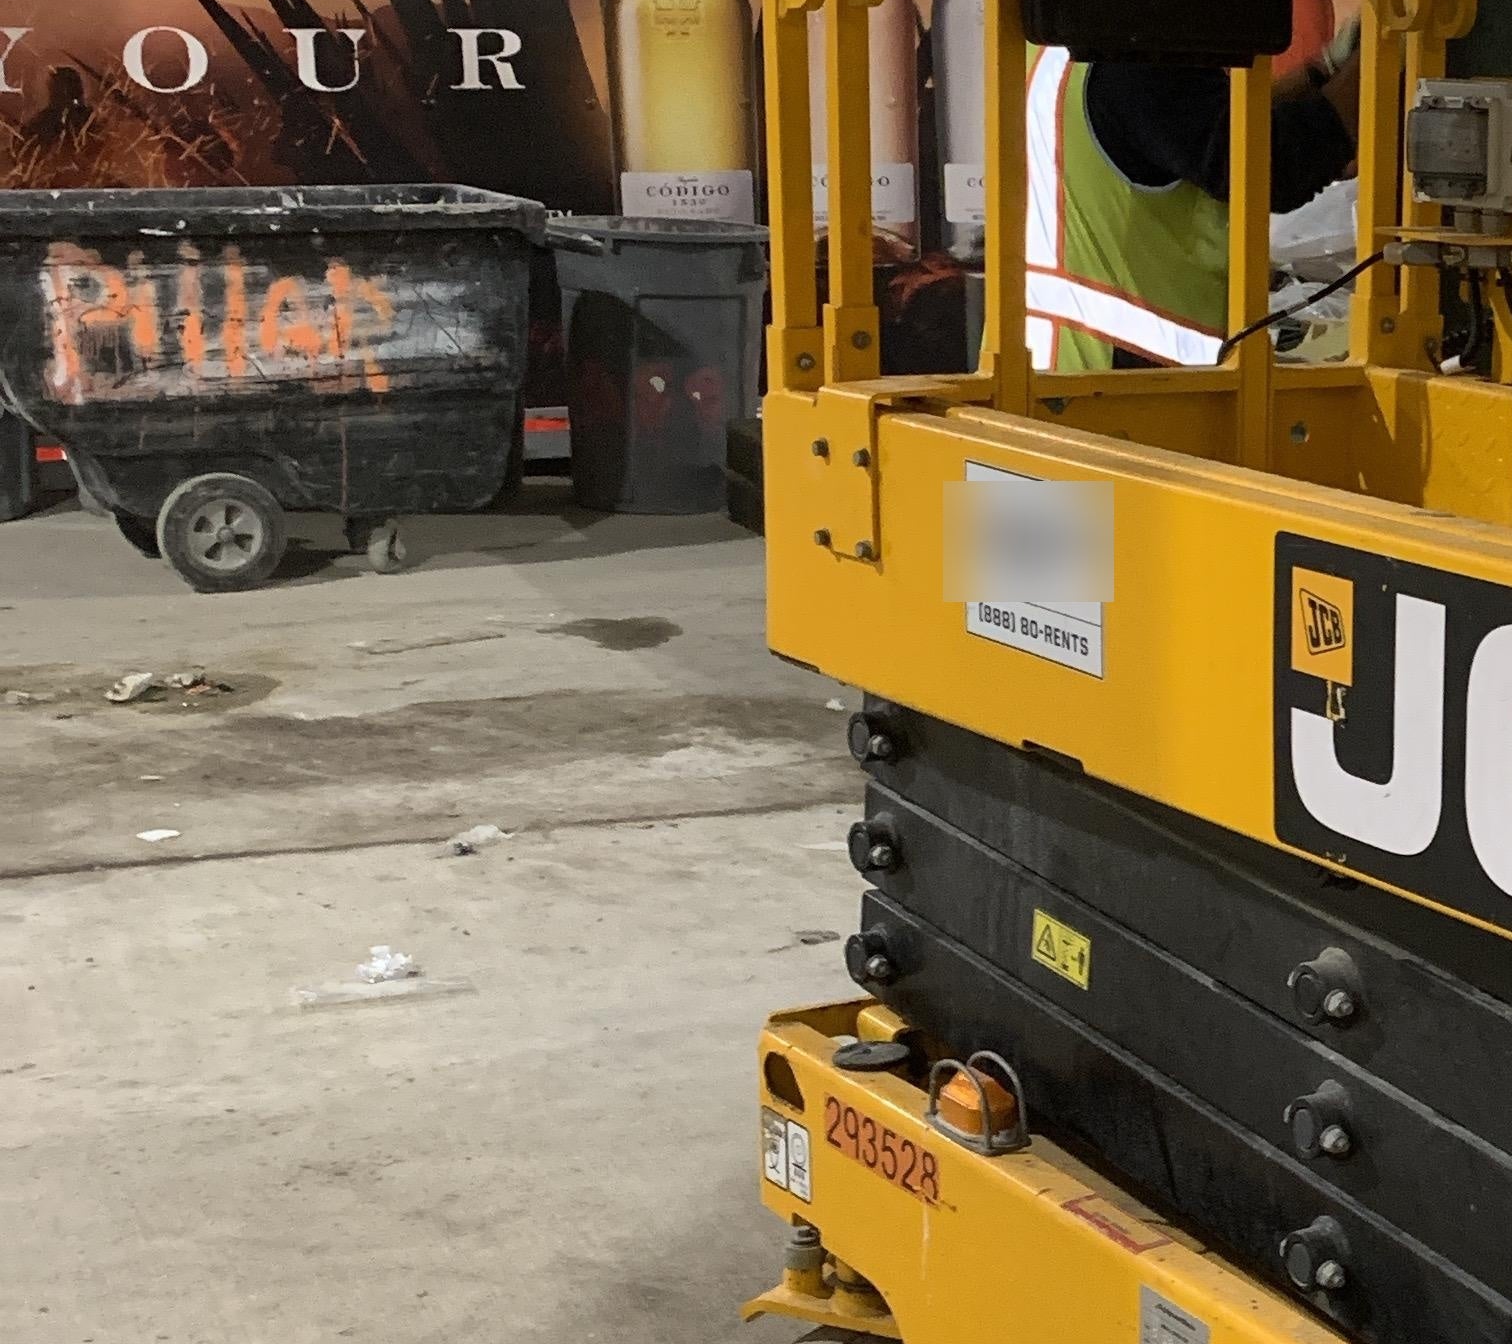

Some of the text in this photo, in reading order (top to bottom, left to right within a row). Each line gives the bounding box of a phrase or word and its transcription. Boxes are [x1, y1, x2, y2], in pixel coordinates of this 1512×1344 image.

[978, 602, 1089, 657] (888) 80-RENTS
[1307, 597, 1342, 648] JCB
[825, 1096, 940, 1206] 293528
